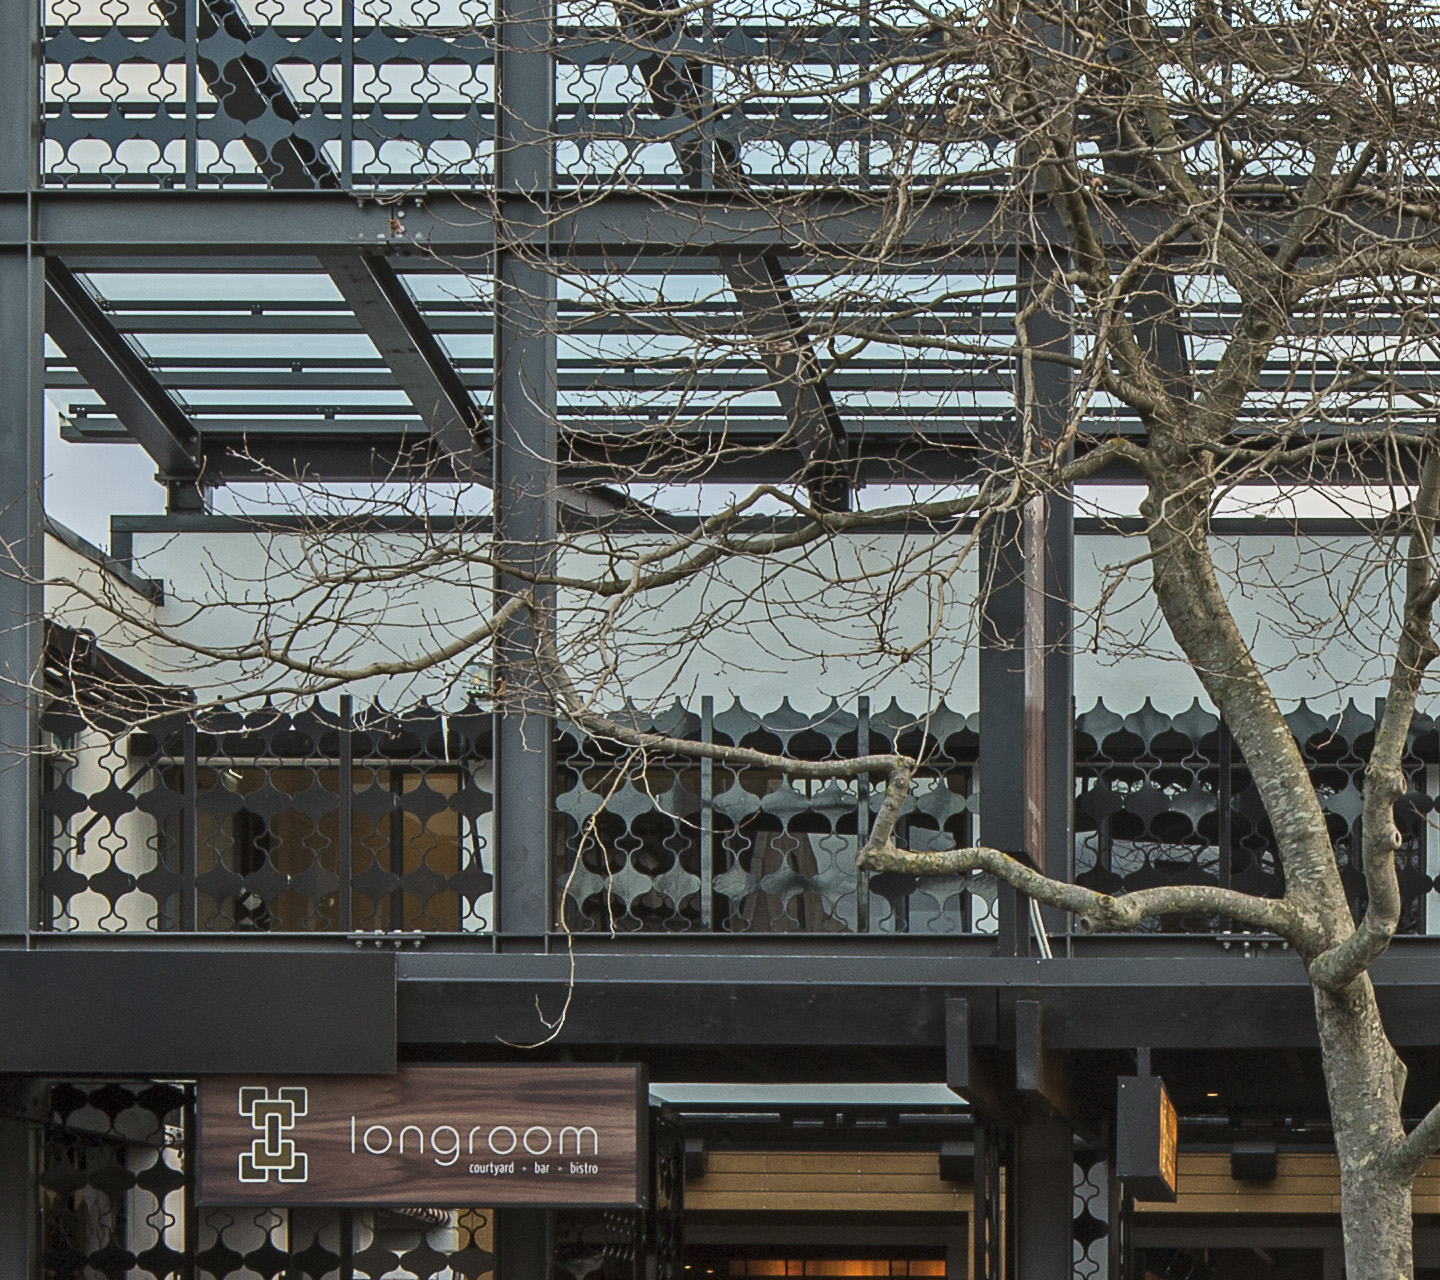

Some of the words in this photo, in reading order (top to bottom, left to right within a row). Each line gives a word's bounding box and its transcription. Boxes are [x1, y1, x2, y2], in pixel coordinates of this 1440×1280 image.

[351, 1116, 598, 1166] longroom
[469, 1162, 514, 1176] courtyard
[534, 1162, 550, 1174] bar
[570, 1162, 598, 1175] bistro
